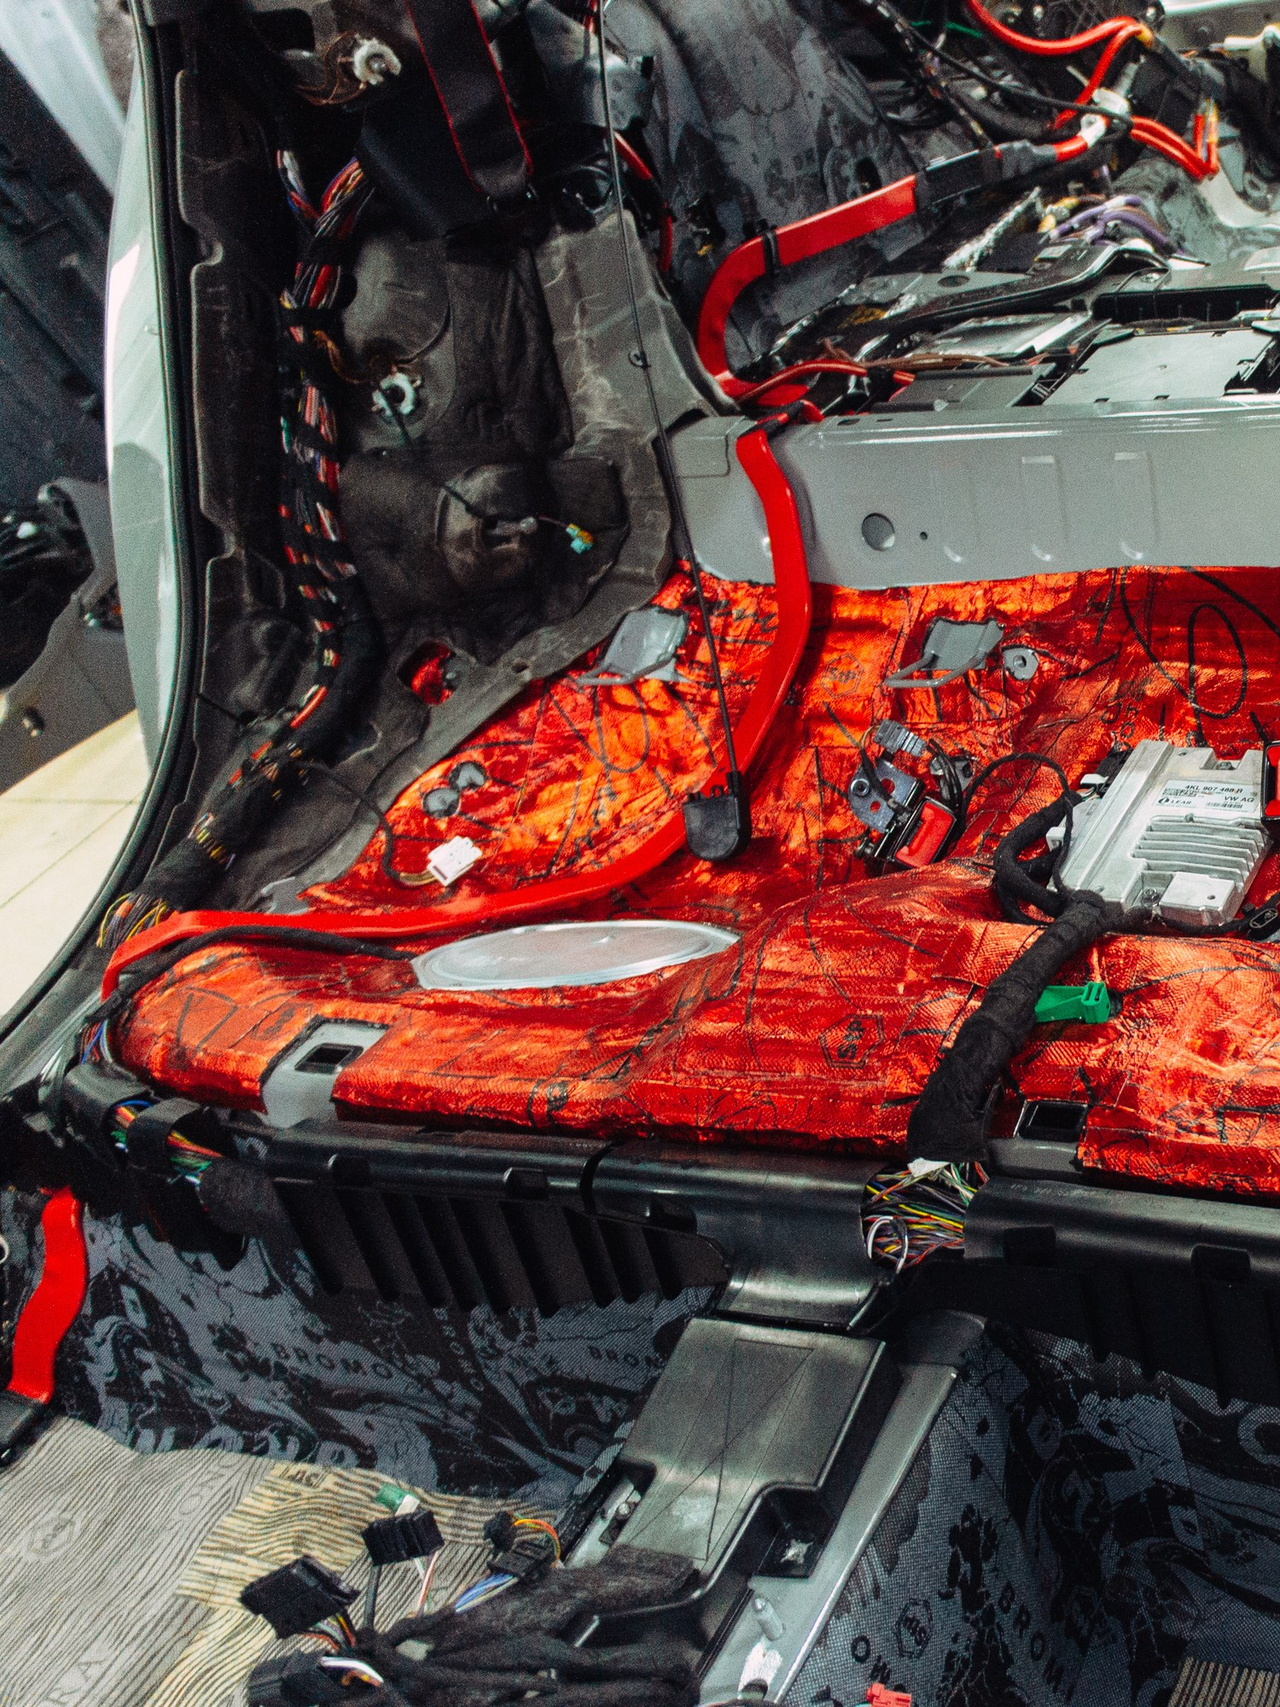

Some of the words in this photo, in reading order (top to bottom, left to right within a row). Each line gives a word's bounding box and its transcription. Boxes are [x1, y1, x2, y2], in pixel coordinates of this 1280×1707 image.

[1240, 796, 1256, 804] AG
[836, 1019, 866, 1061] StP
[269, 1341, 394, 1380] BROMO
